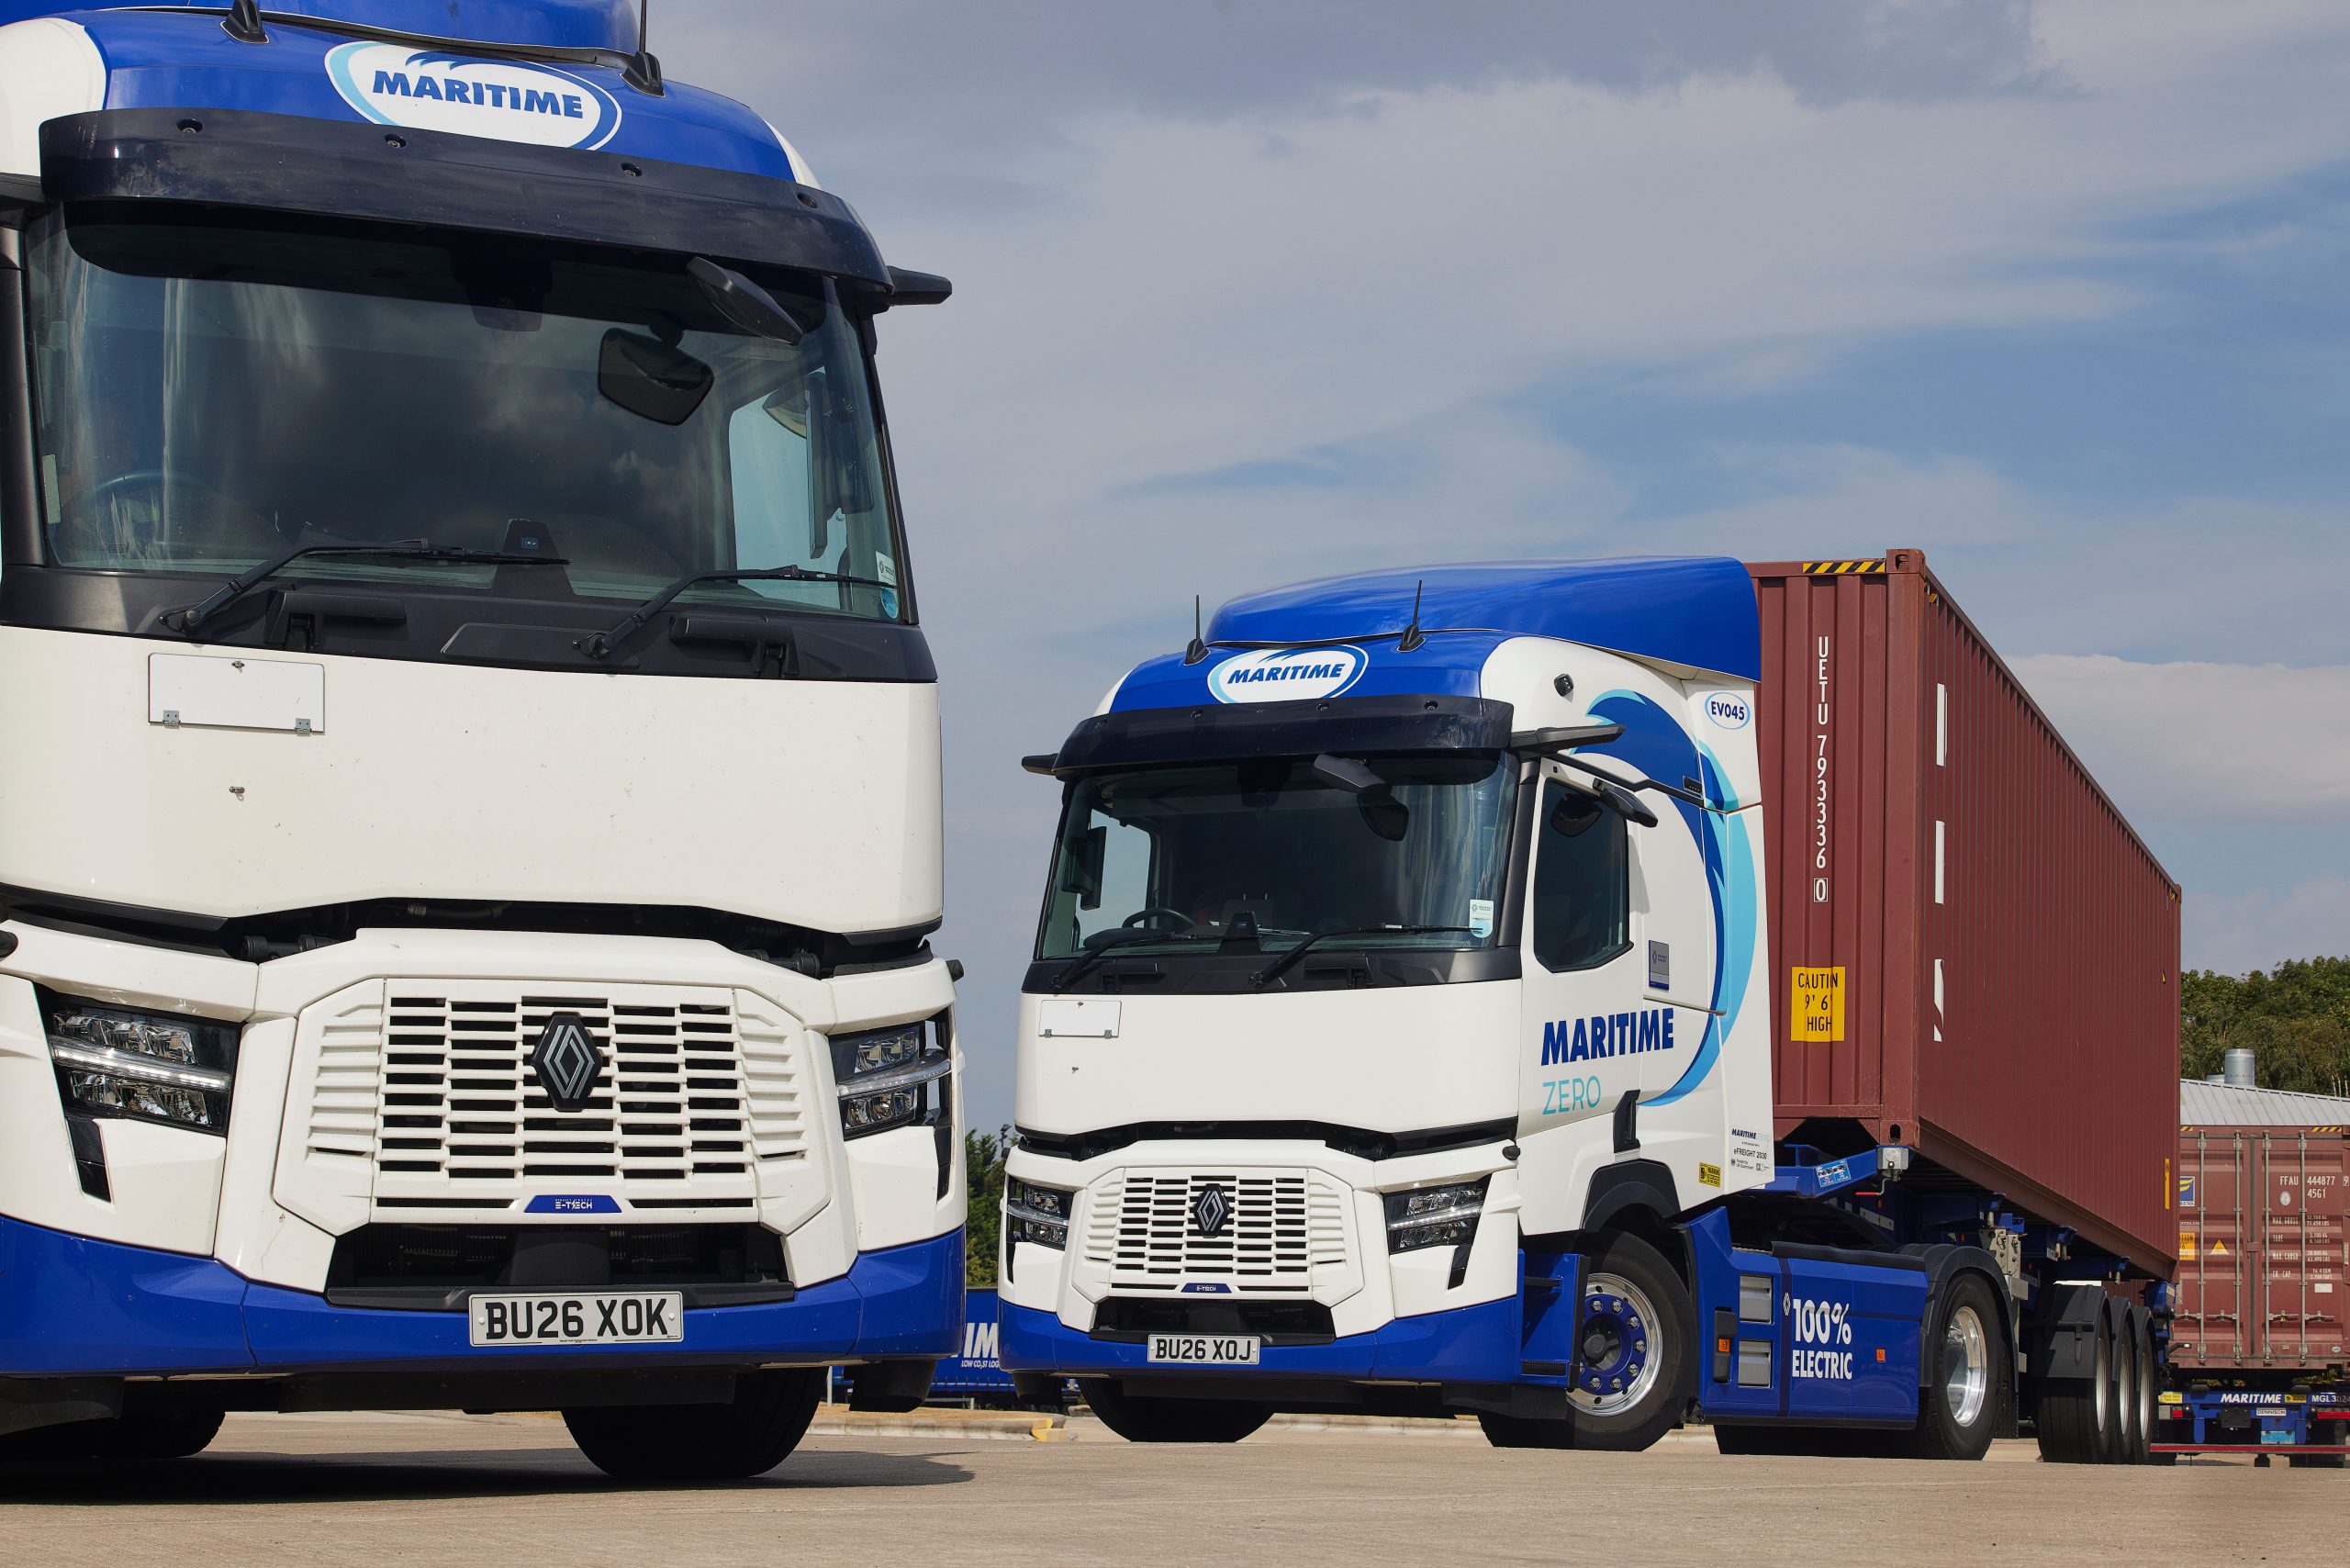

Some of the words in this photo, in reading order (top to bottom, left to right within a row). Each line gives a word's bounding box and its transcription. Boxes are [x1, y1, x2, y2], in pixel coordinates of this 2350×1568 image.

[373, 70, 583, 119] MARITIME
[1227, 663, 1346, 685] MARITIME
[1818, 635, 1829, 725] UETU
[1711, 700, 1745, 721] EV045
[1816, 734, 1828, 868] 793336
[1815, 879, 1827, 902] 0
[1807, 1016, 1832, 1032] HIGH
[1541, 1007, 1674, 1066] MARITIME
[1542, 1075, 1601, 1115] ZERO
[1732, 1128, 1756, 1139] MARITIME
[2279, 1175, 2299, 1185] FFAU
[2306, 1175, 2335, 1185] 444877
[2307, 1188, 2326, 1199] 45G1
[554, 1201, 593, 1210] E-TECH
[485, 1300, 584, 1340] BU26
[596, 1298, 668, 1337] XOK
[1793, 1298, 1852, 1345] 100%
[1155, 1338, 1207, 1360] BU26
[1212, 1339, 1251, 1361] XOJ
[1792, 1350, 1853, 1380] ELECTRIC
[2221, 1393, 2282, 1404] MARITIME
